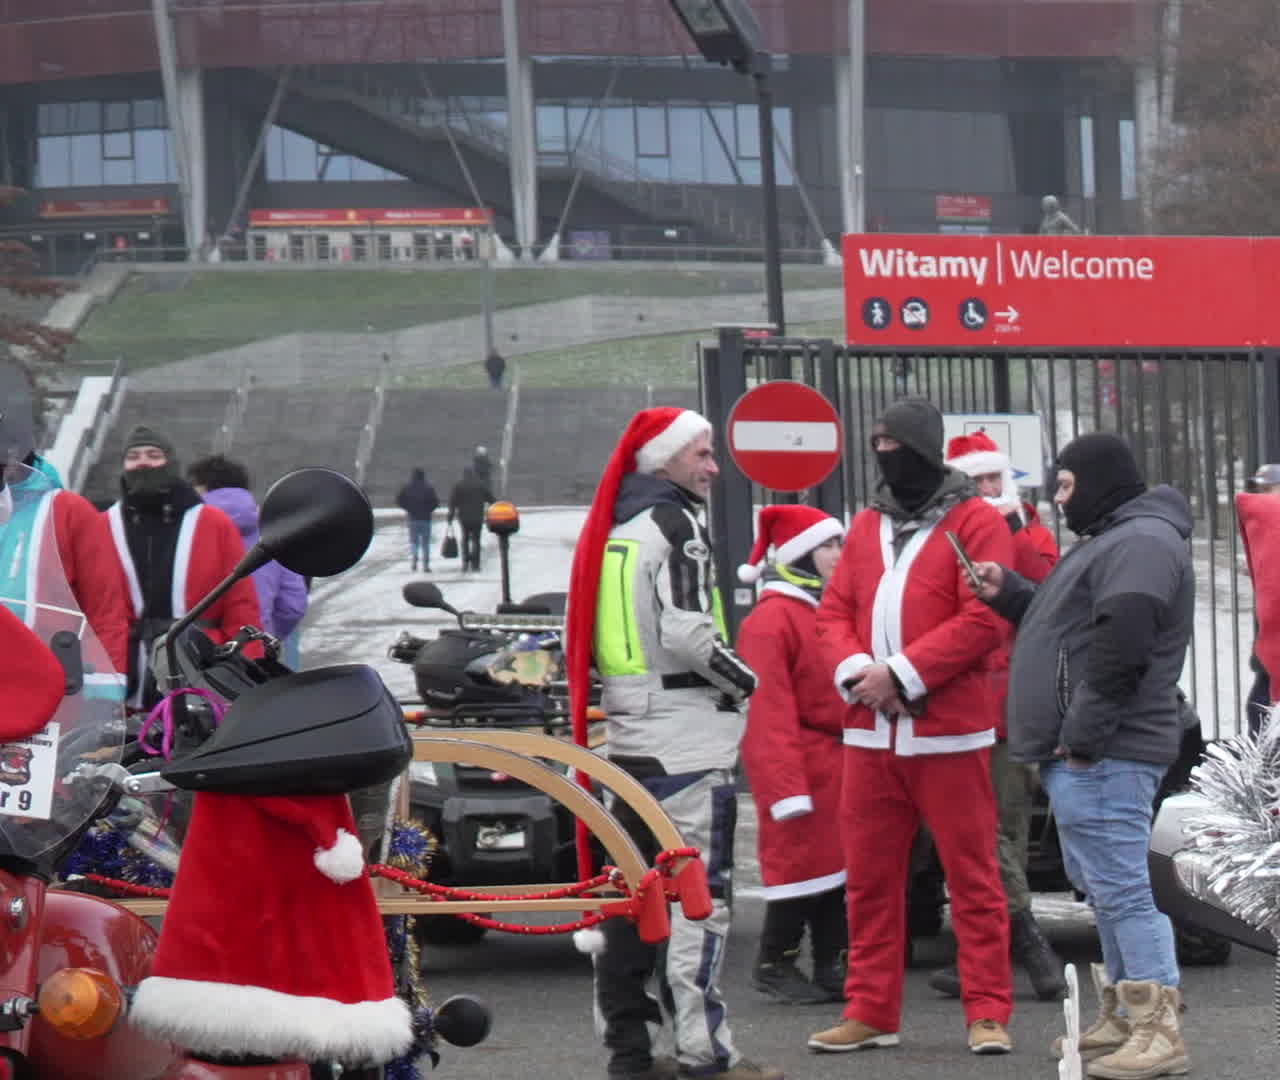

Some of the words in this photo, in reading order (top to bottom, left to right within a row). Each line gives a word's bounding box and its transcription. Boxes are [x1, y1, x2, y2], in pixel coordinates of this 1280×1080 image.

[859, 247, 989, 286] Witamy
[1010, 249, 1154, 280] Welcome
[17, 790, 32, 811] 9
